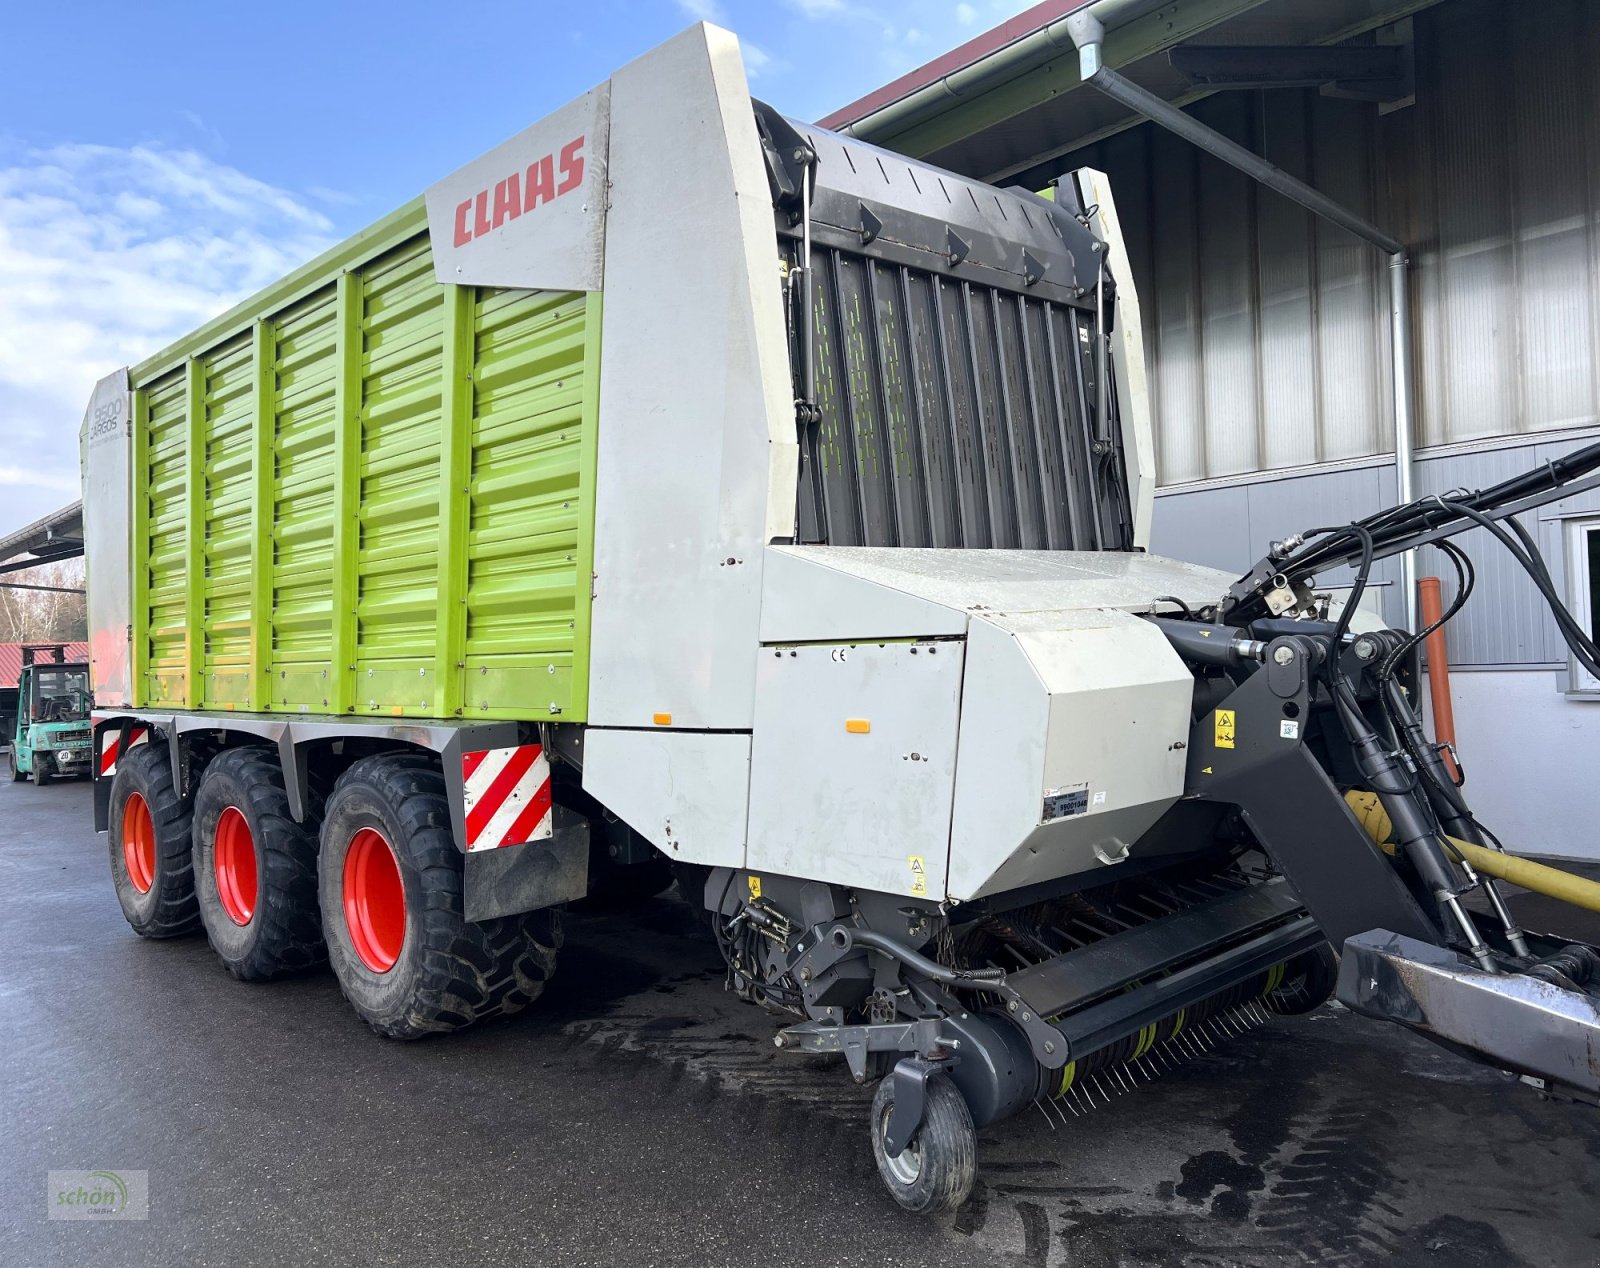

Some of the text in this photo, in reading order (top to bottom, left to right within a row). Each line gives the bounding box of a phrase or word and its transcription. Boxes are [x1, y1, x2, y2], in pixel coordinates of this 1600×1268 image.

[453, 135, 585, 248] CLAAS
[95, 398, 122, 423] 9500
[60, 751, 69, 760] 20
